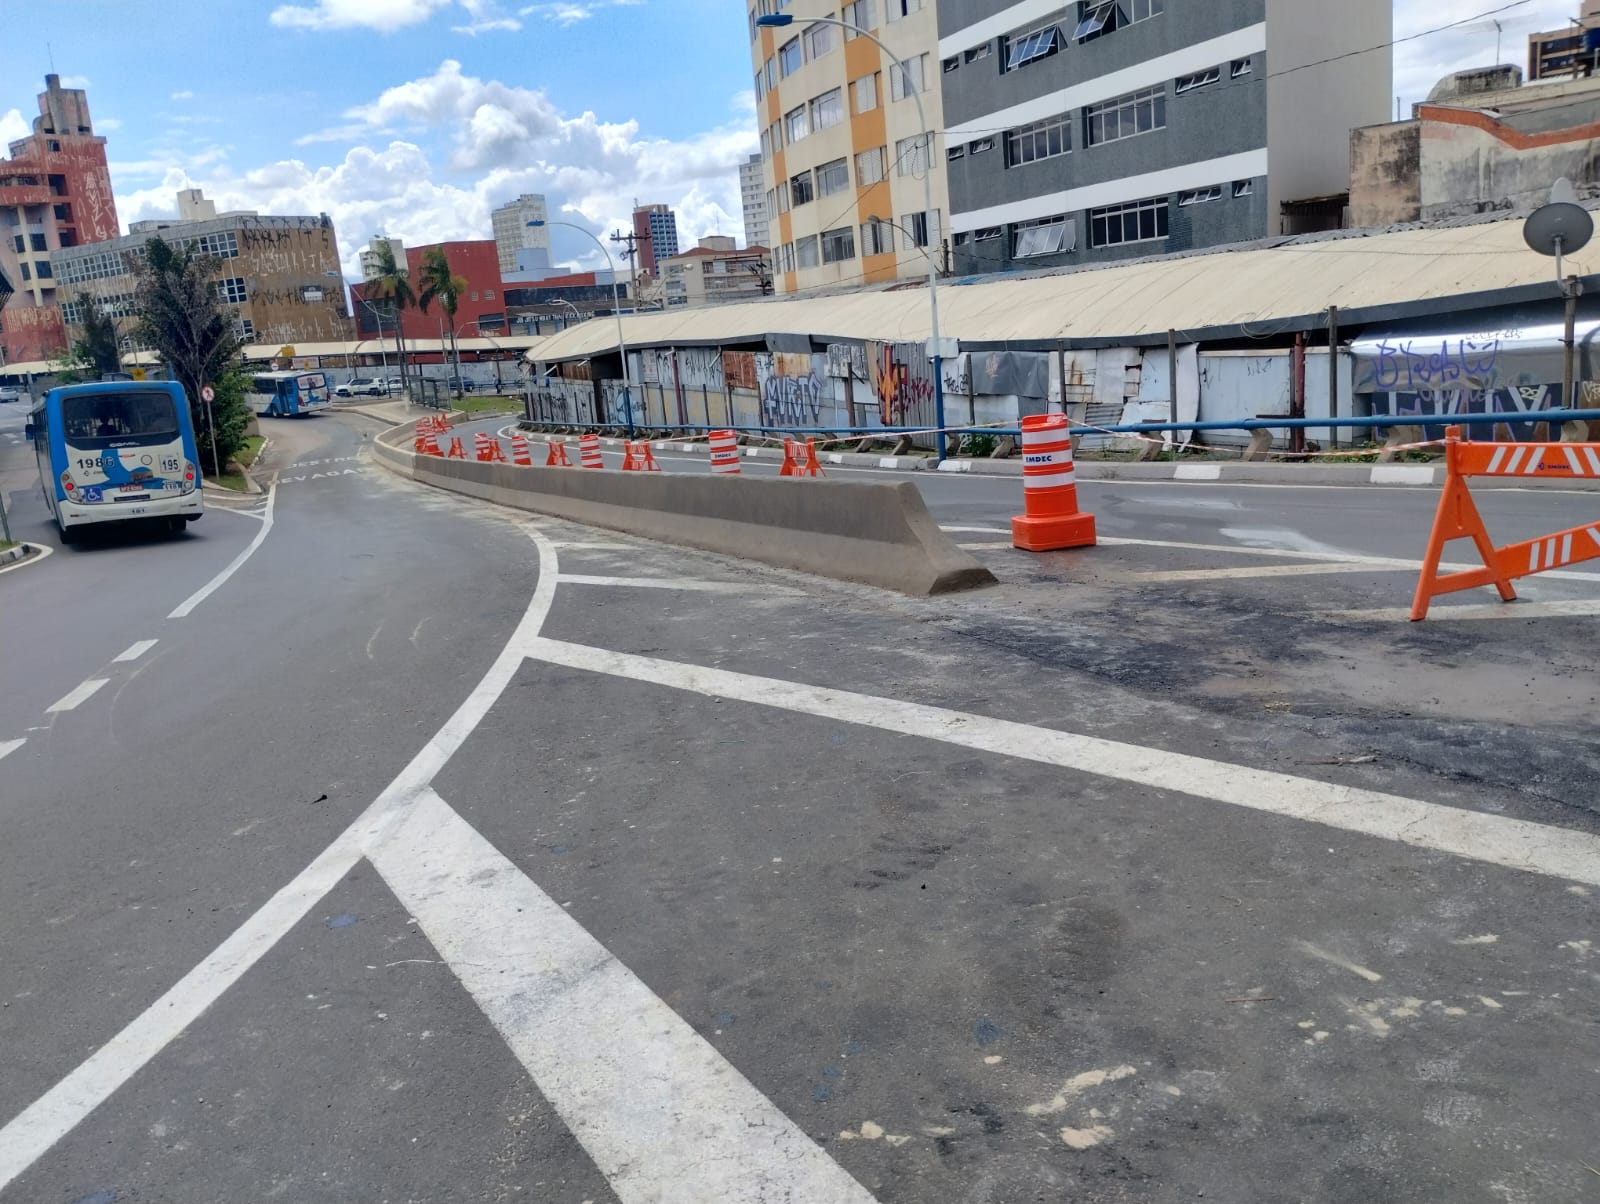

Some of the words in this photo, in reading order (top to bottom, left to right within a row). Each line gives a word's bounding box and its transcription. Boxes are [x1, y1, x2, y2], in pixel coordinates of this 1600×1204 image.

[76, 456, 115, 469] 1986
[1025, 455, 1052, 463] EMDEC
[162, 460, 179, 471] 195
